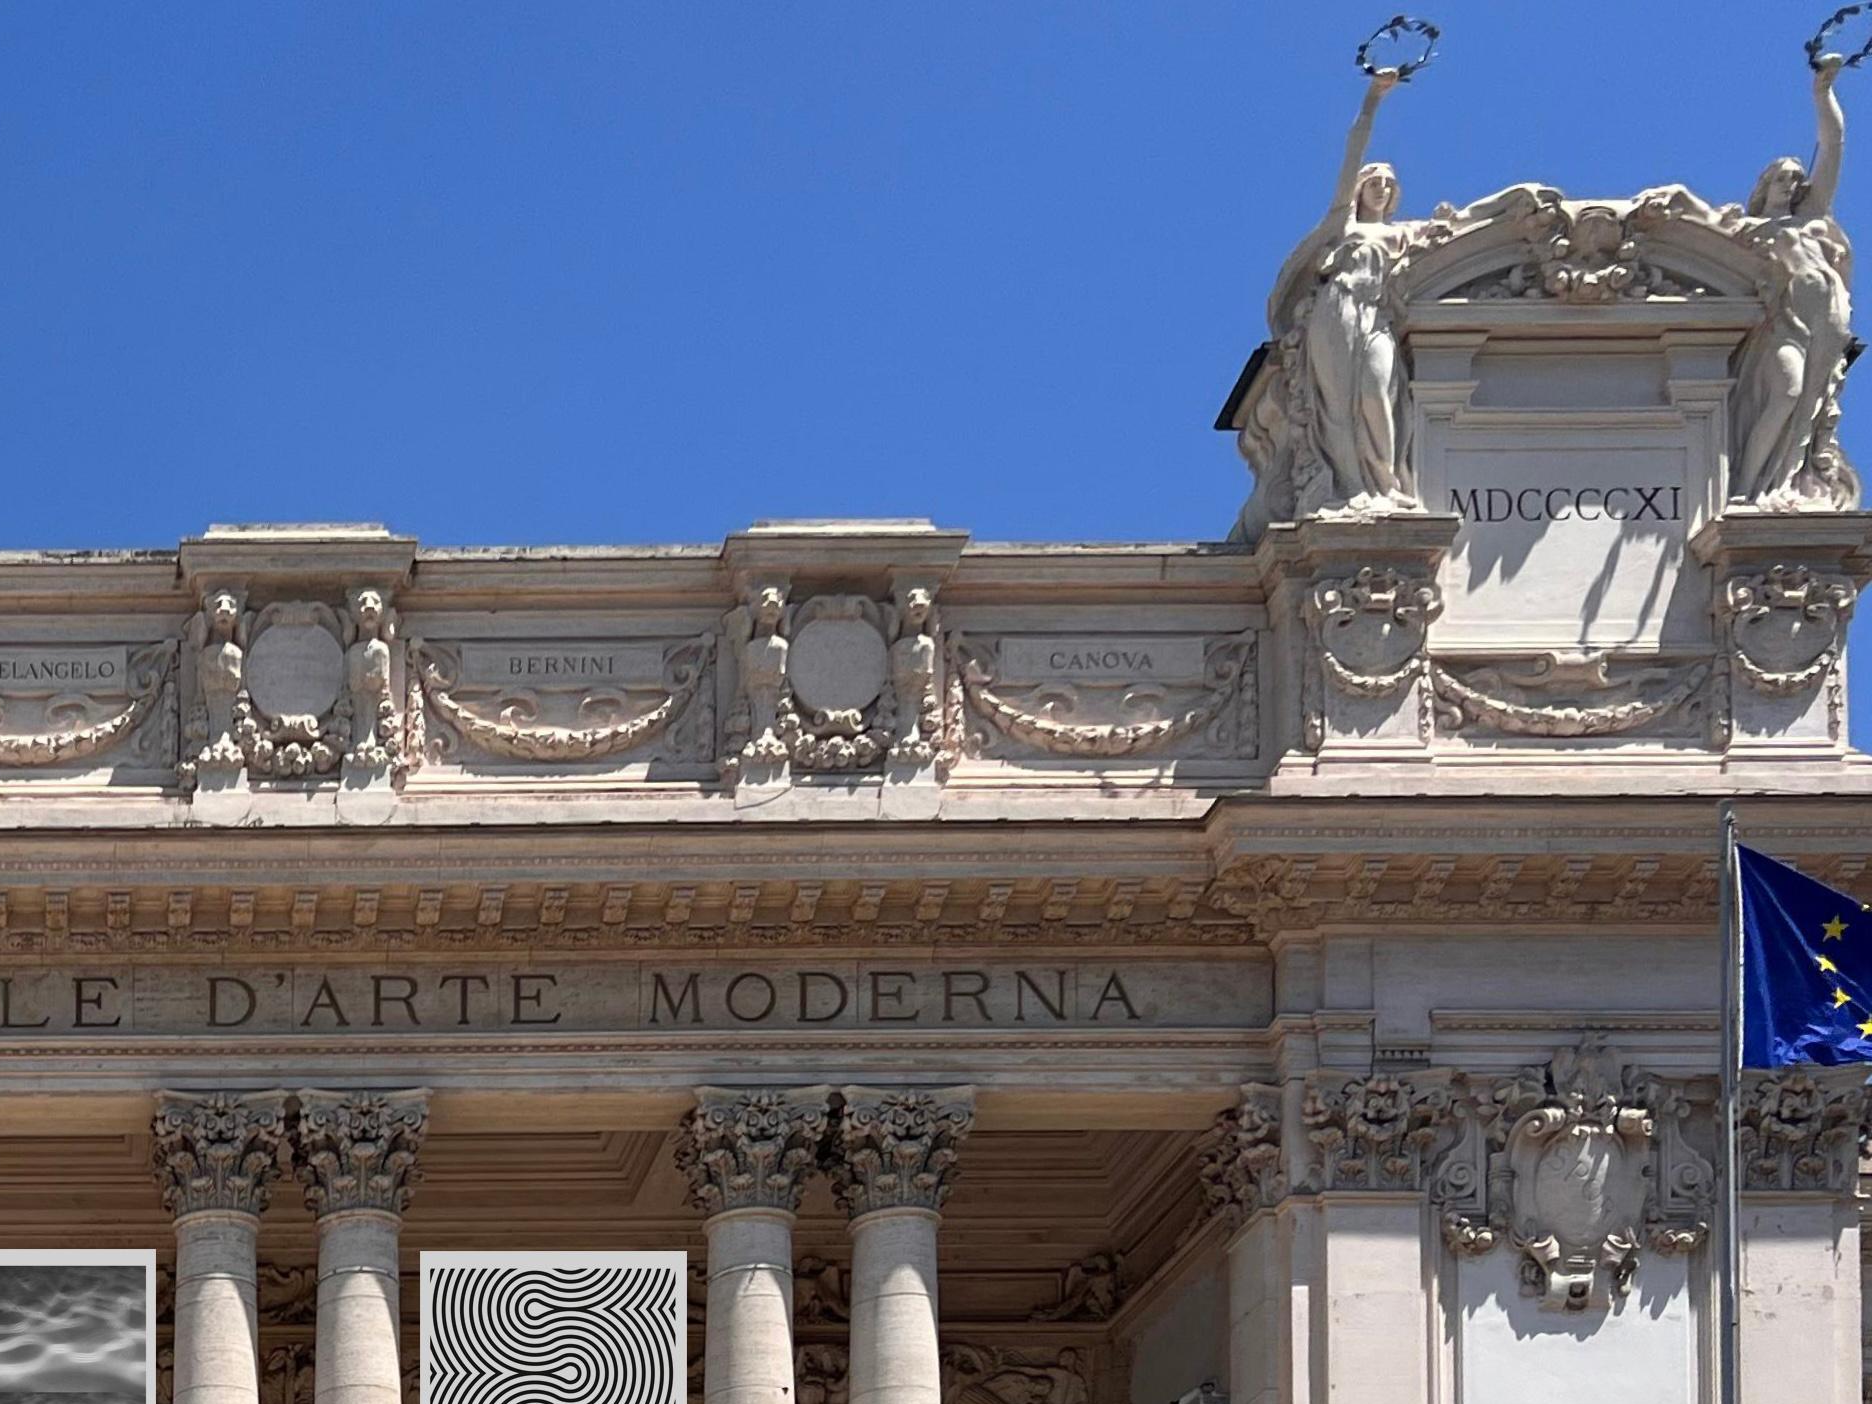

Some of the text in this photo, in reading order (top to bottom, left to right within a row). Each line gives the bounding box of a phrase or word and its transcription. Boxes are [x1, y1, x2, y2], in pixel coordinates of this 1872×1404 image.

[1449, 487, 1683, 523] MDCCCCXI
[509, 656, 614, 674] BERNINI
[1049, 652, 1153, 669] CANOVA
[206, 972, 562, 1027] D'ARTE
[649, 969, 1141, 1023] MODERNA
